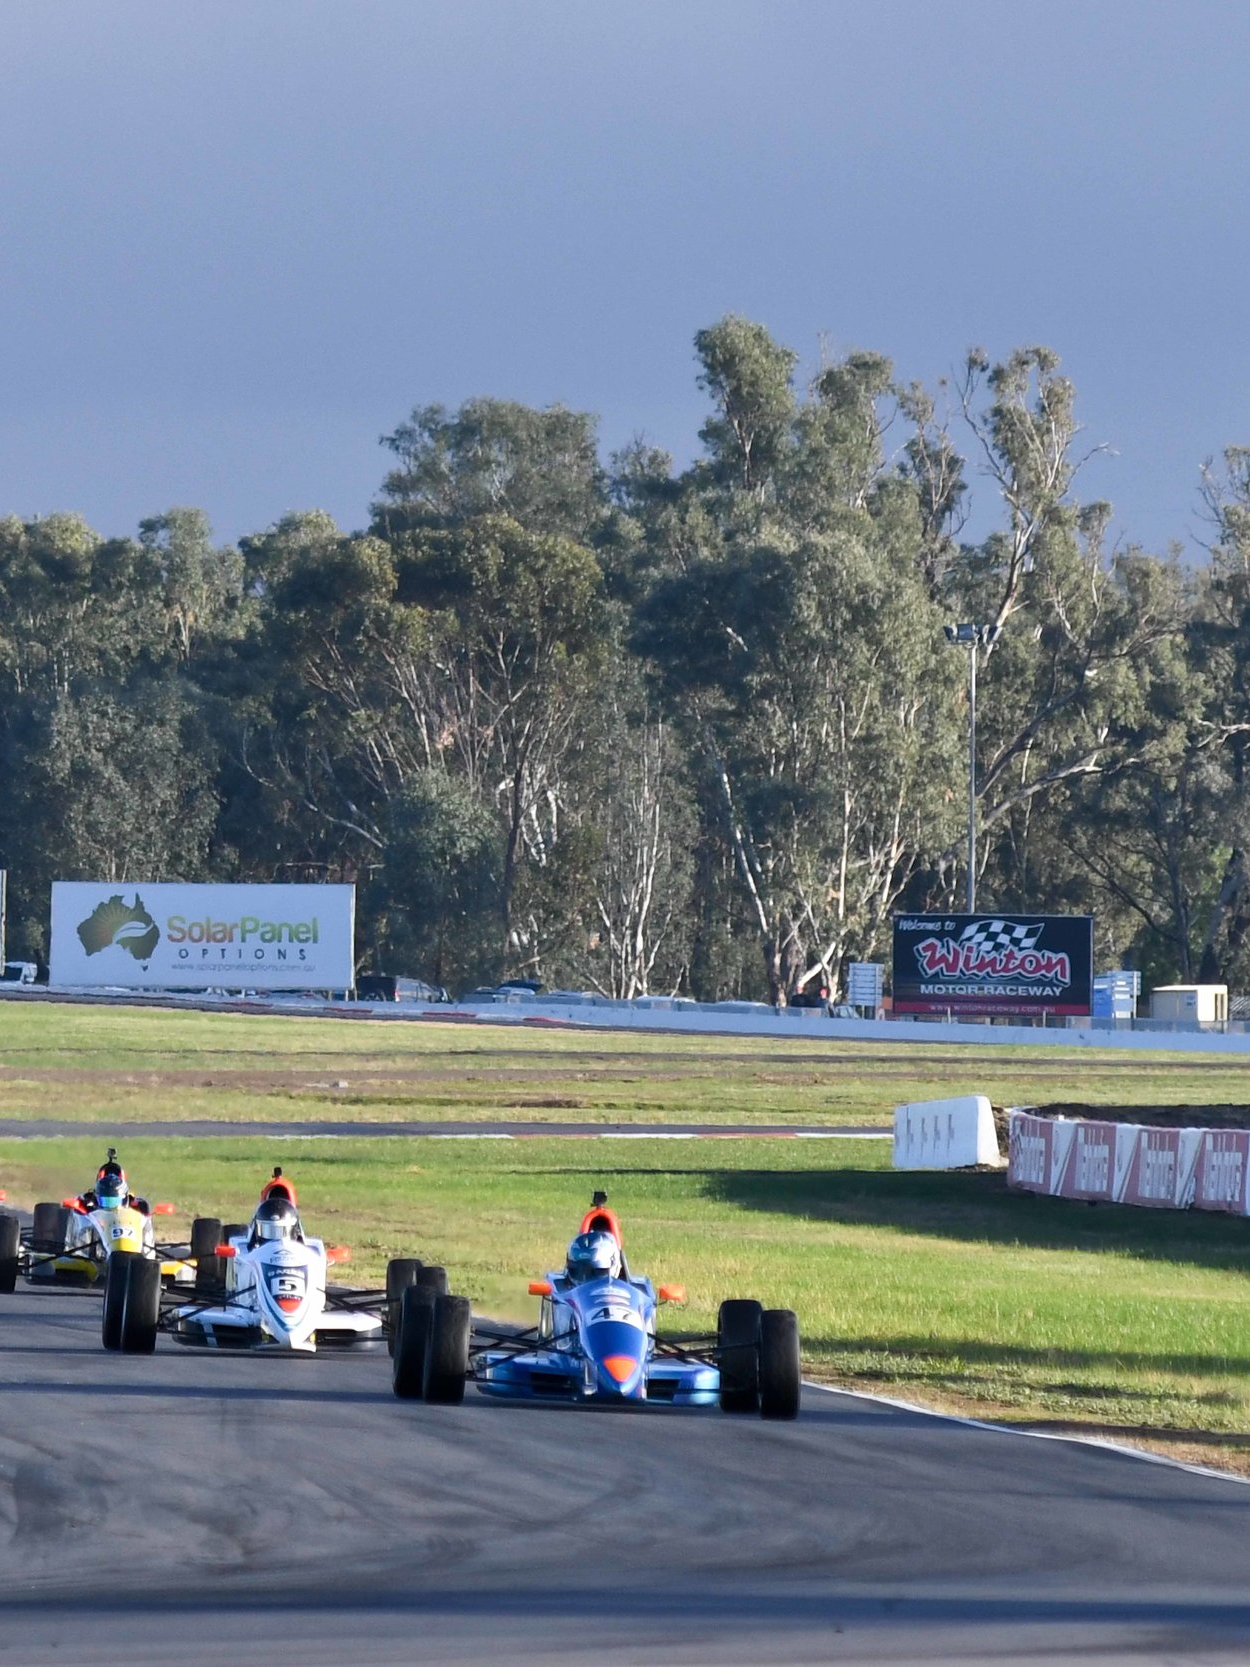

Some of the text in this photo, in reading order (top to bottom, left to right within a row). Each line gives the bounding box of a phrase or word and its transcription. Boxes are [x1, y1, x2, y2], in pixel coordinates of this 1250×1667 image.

[166, 915, 319, 945] SolarPanel
[899, 919, 957, 931] Welcome to
[178, 948, 307, 961] OPTIONS
[916, 938, 1070, 983] Winton
[920, 984, 1064, 997] MOTOR RACEWAY
[278, 1279, 297, 1292] 5
[591, 1307, 632, 1321] 47
